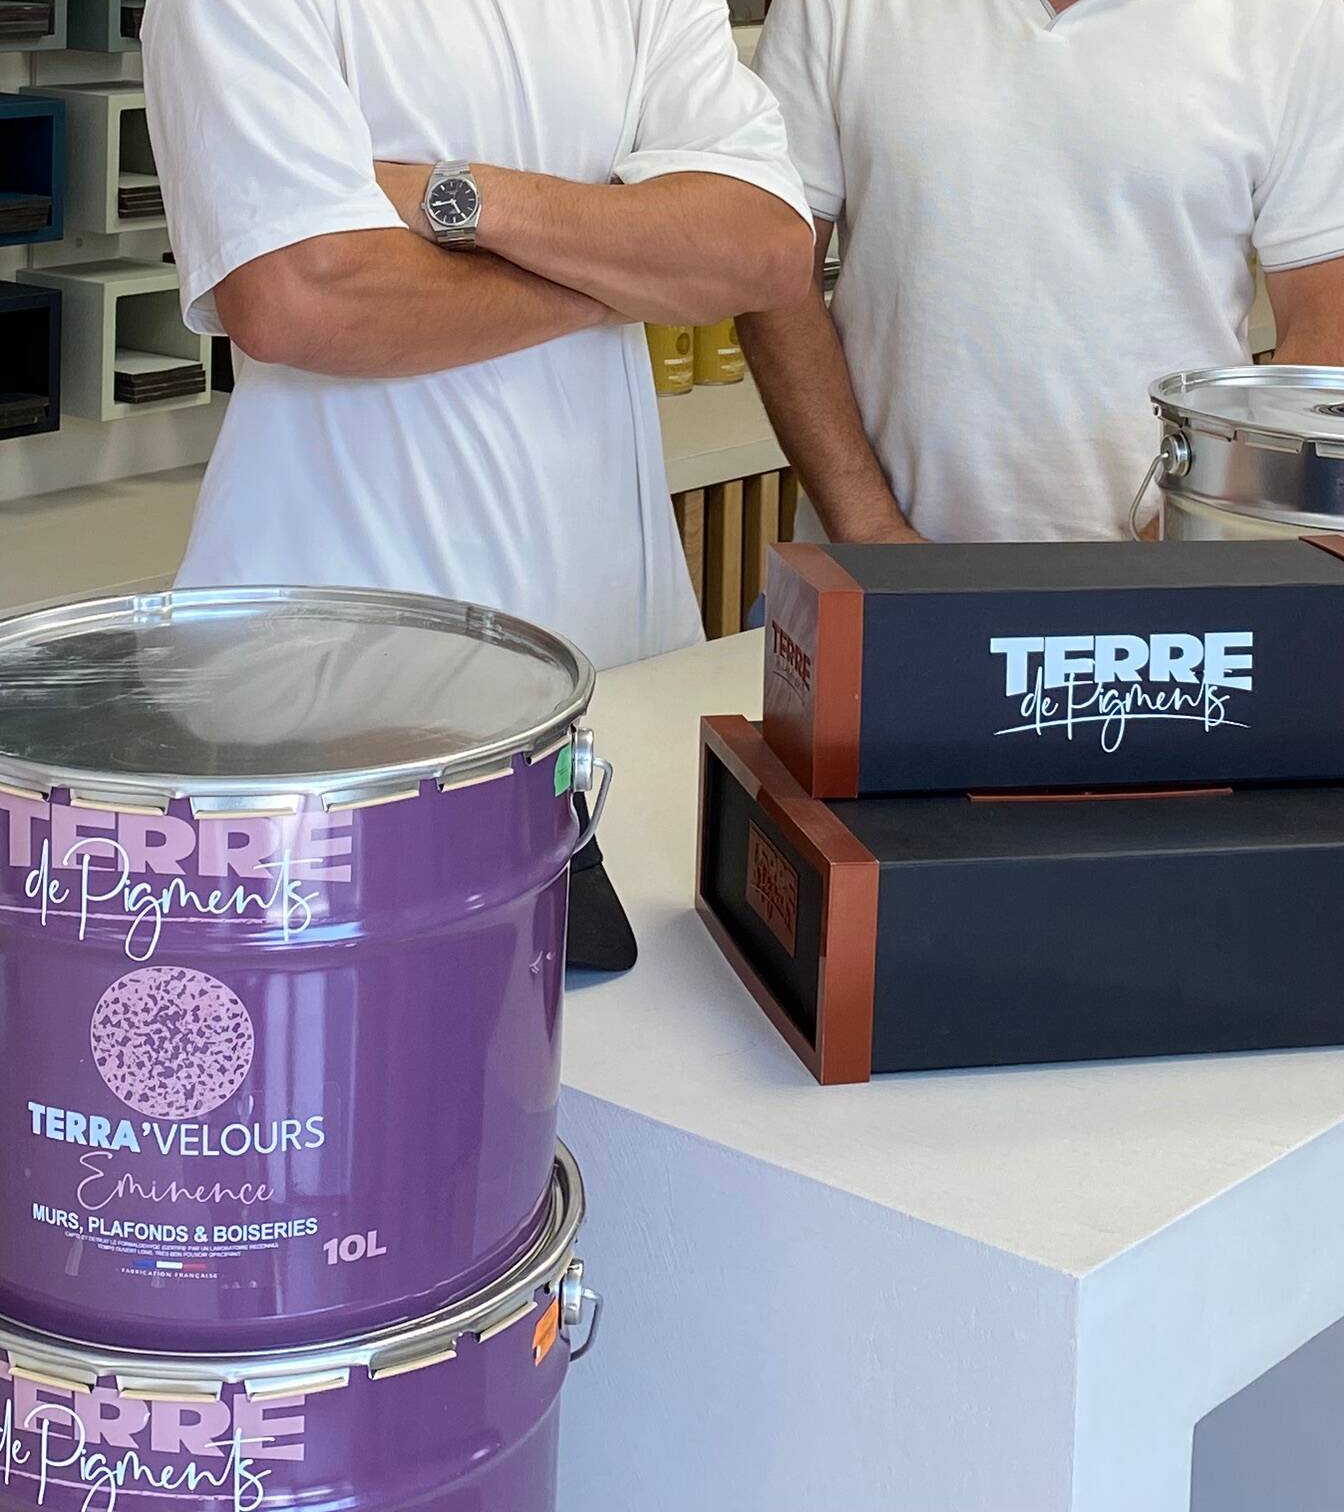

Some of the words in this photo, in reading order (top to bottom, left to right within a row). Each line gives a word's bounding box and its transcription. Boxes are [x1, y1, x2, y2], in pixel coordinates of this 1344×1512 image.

[990, 631, 1254, 697] TERRE
[1019, 666, 1059, 736] de
[1065, 660, 1233, 753] Pigments
[25, 838, 69, 926] de
[62, 837, 323, 961] Pigments
[27, 1101, 326, 1156] TERRA'VELOURS
[77, 1150, 275, 1211] Eminence
[32, 1202, 84, 1235] MURS,
[88, 1216, 188, 1242] PLAFONDS
[194, 1226, 208, 1243] &
[213, 1218, 318, 1243] BOISERIES
[323, 1230, 387, 1266] 10L
[23, 1402, 276, 1512] Pigments
